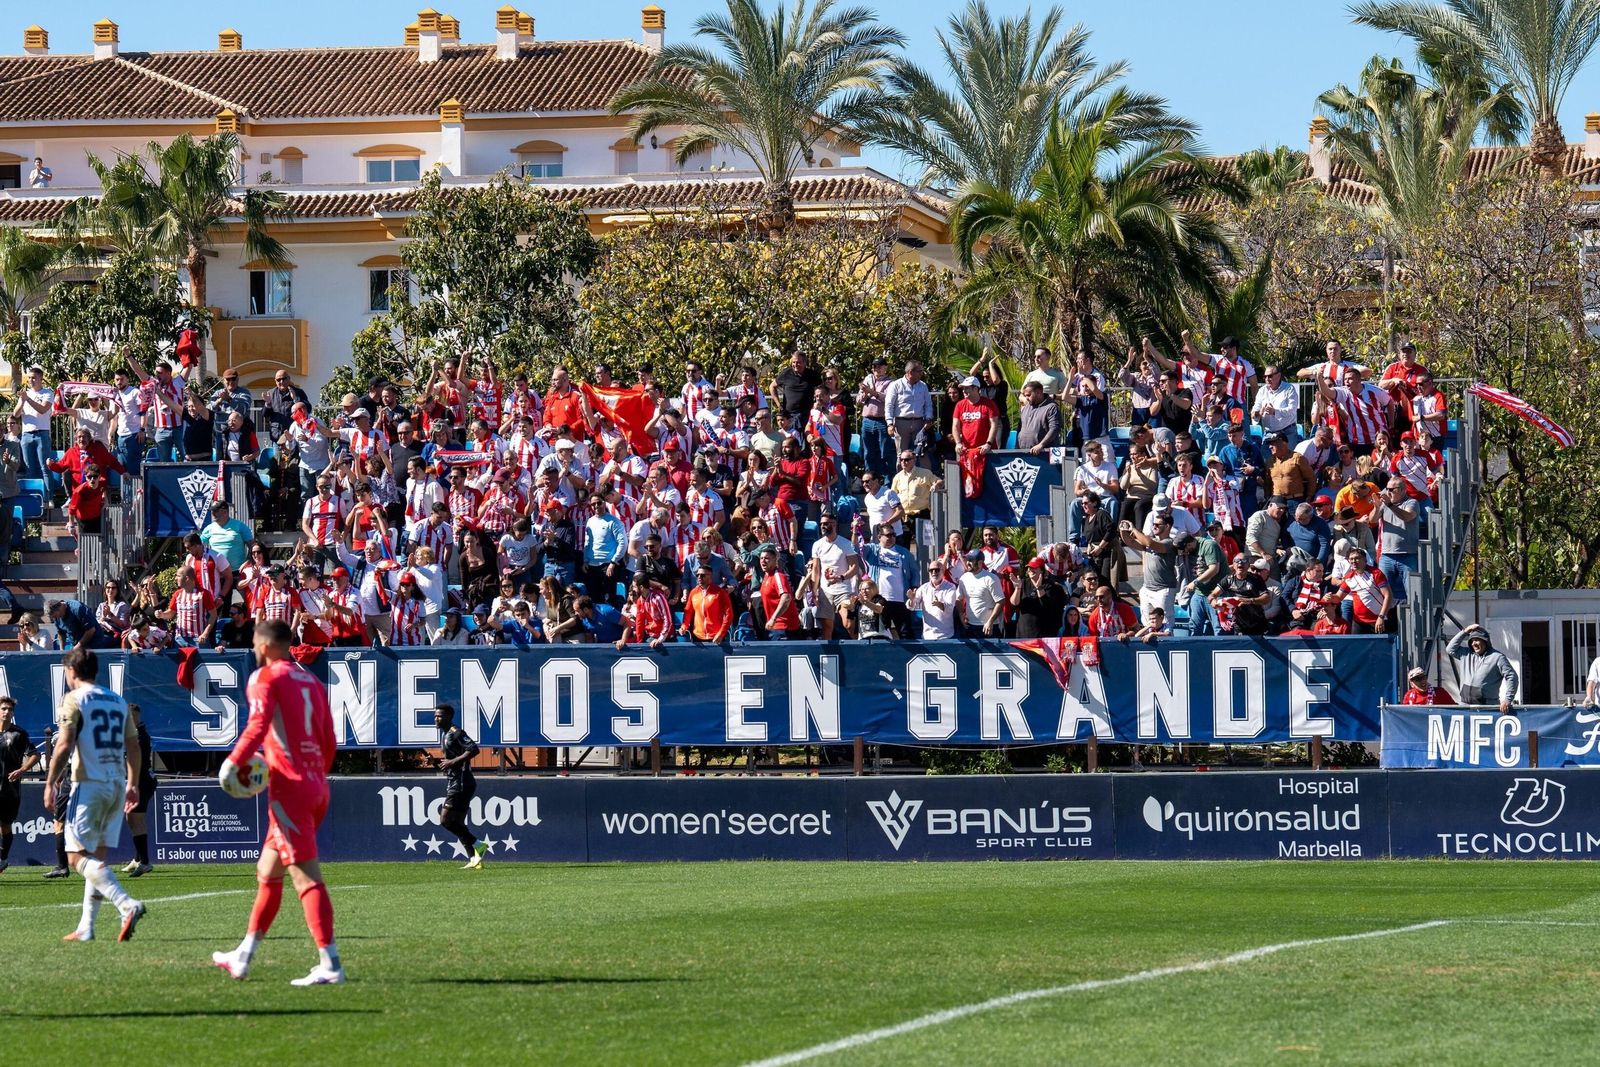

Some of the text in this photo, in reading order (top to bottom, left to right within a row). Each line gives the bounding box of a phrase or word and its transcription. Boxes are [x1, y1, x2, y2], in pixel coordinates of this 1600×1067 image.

[190, 651, 660, 747] SÑEMOS
[724, 654, 841, 742] EN
[905, 649, 1335, 741] GRANDE
[91, 708, 124, 750] 22
[1427, 714, 1522, 768] MFC
[163, 792, 186, 802] sabor
[1278, 778, 1359, 798] Hospital
[163, 802, 171, 811] a
[926, 800, 1093, 835] BANÚS
[164, 811, 212, 839] laga
[602, 809, 831, 836] women'secret
[1174, 803, 1361, 841] quirónsalud
[157, 847, 260, 862] El sabor que nos une
[976, 837, 1093, 848] SPORT CLUB
[1278, 840, 1362, 857] Marbella
